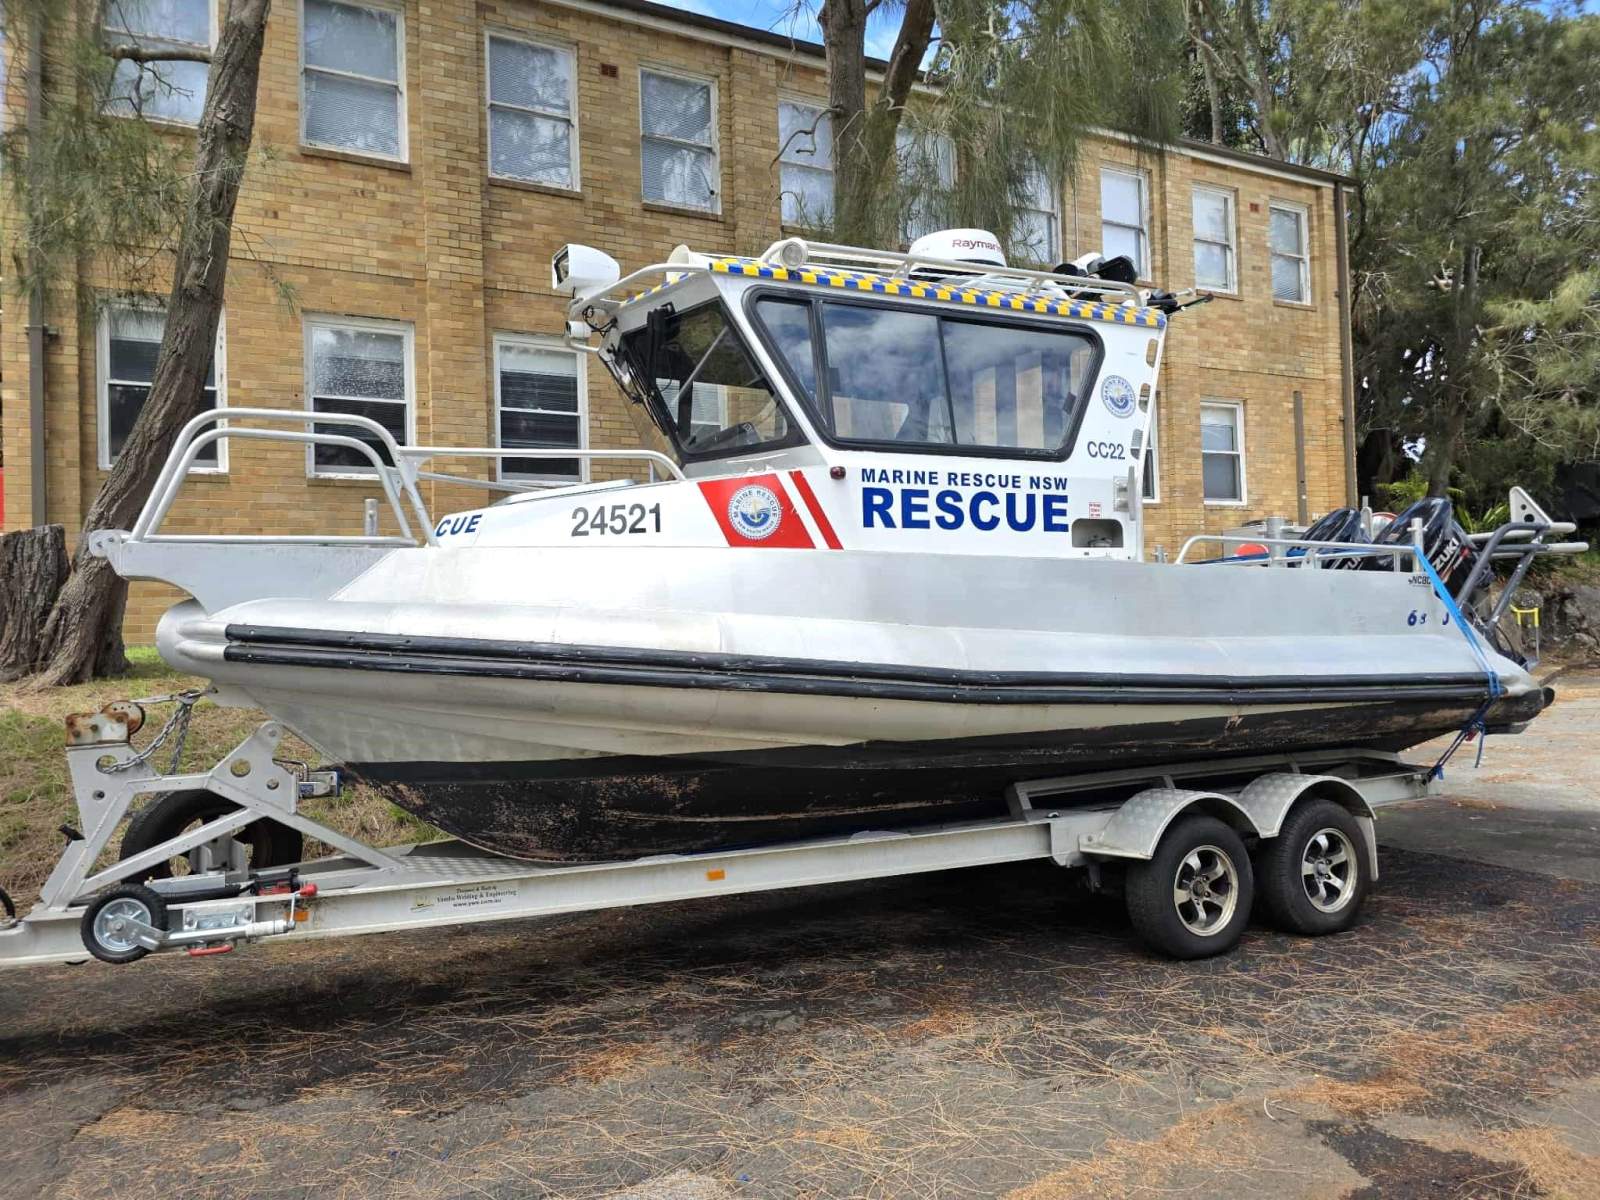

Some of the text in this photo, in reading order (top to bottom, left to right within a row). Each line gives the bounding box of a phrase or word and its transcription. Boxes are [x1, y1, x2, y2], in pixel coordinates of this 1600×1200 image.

[1087, 441, 1126, 460] CC22
[861, 468, 1068, 491] MARINE RESCUE NSW
[571, 503, 661, 537] 24521
[862, 487, 1069, 533] RESCUE
[435, 514, 483, 537] CUE
[1431, 536, 1460, 572] ZUKI
